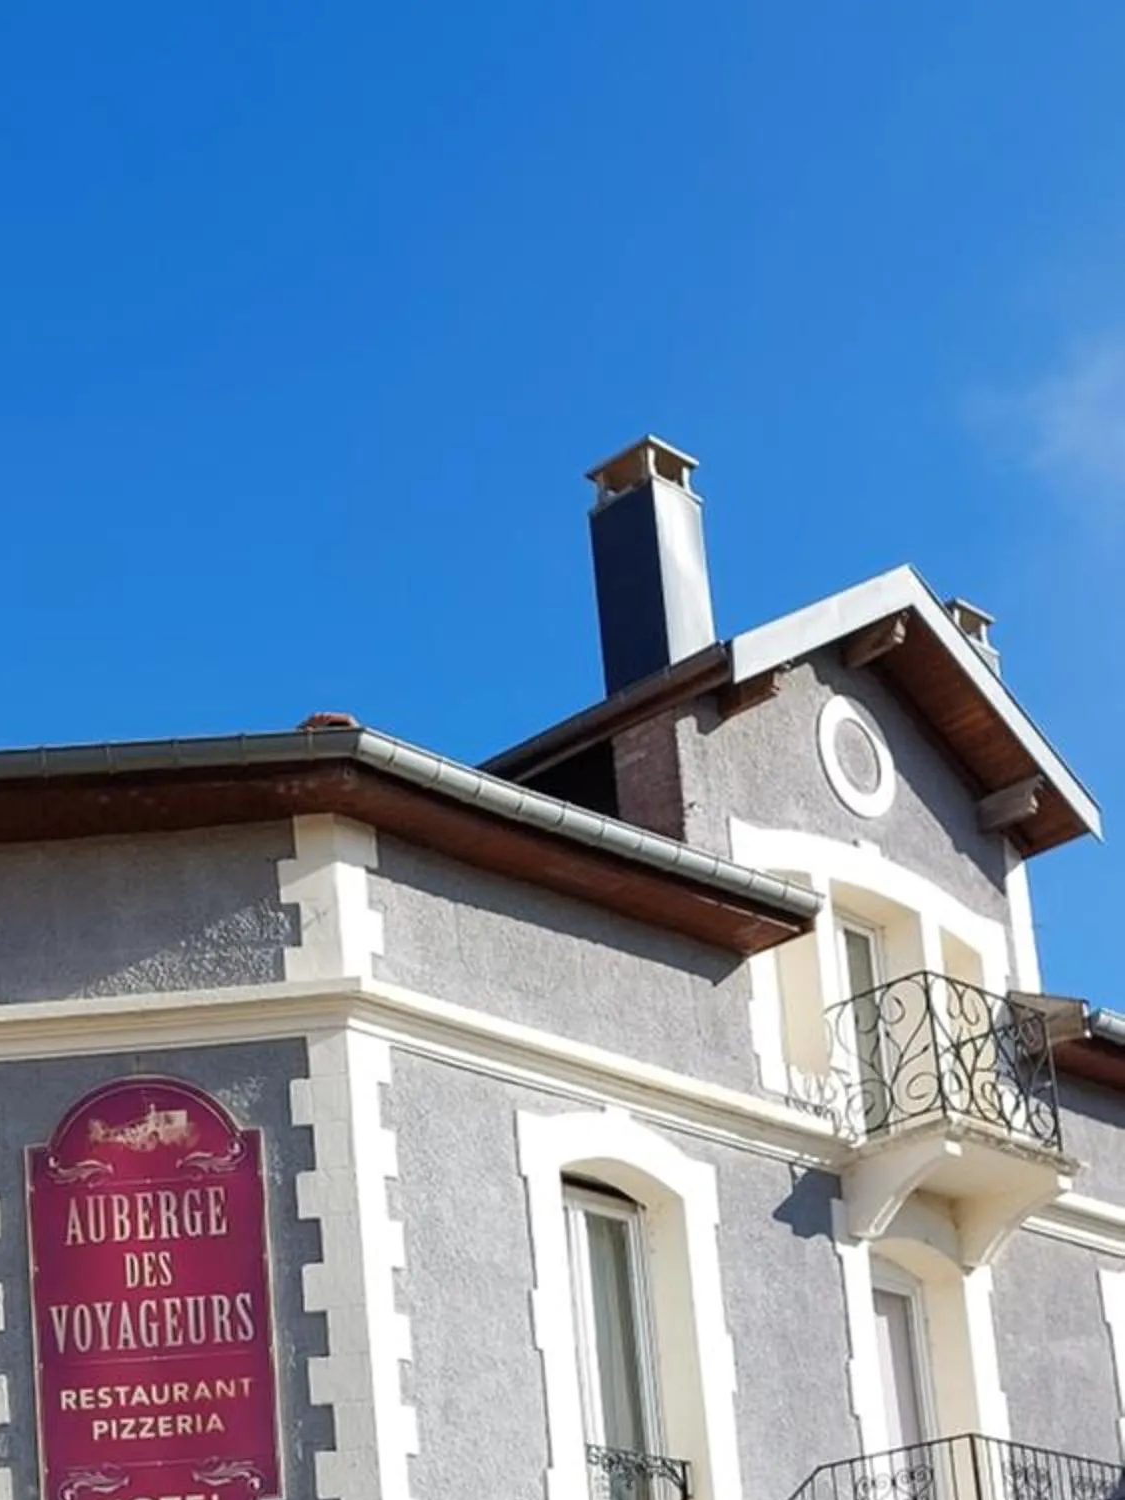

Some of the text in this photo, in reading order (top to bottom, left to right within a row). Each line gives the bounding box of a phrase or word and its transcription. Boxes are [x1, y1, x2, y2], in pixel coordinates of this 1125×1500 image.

[65, 1186, 228, 1246] AUBERGE
[124, 1250, 173, 1289] DES
[49, 1292, 255, 1354] VOYAGEURS
[59, 1377, 254, 1411] RESTAURANT
[92, 1412, 226, 1441] PIZZERIA
